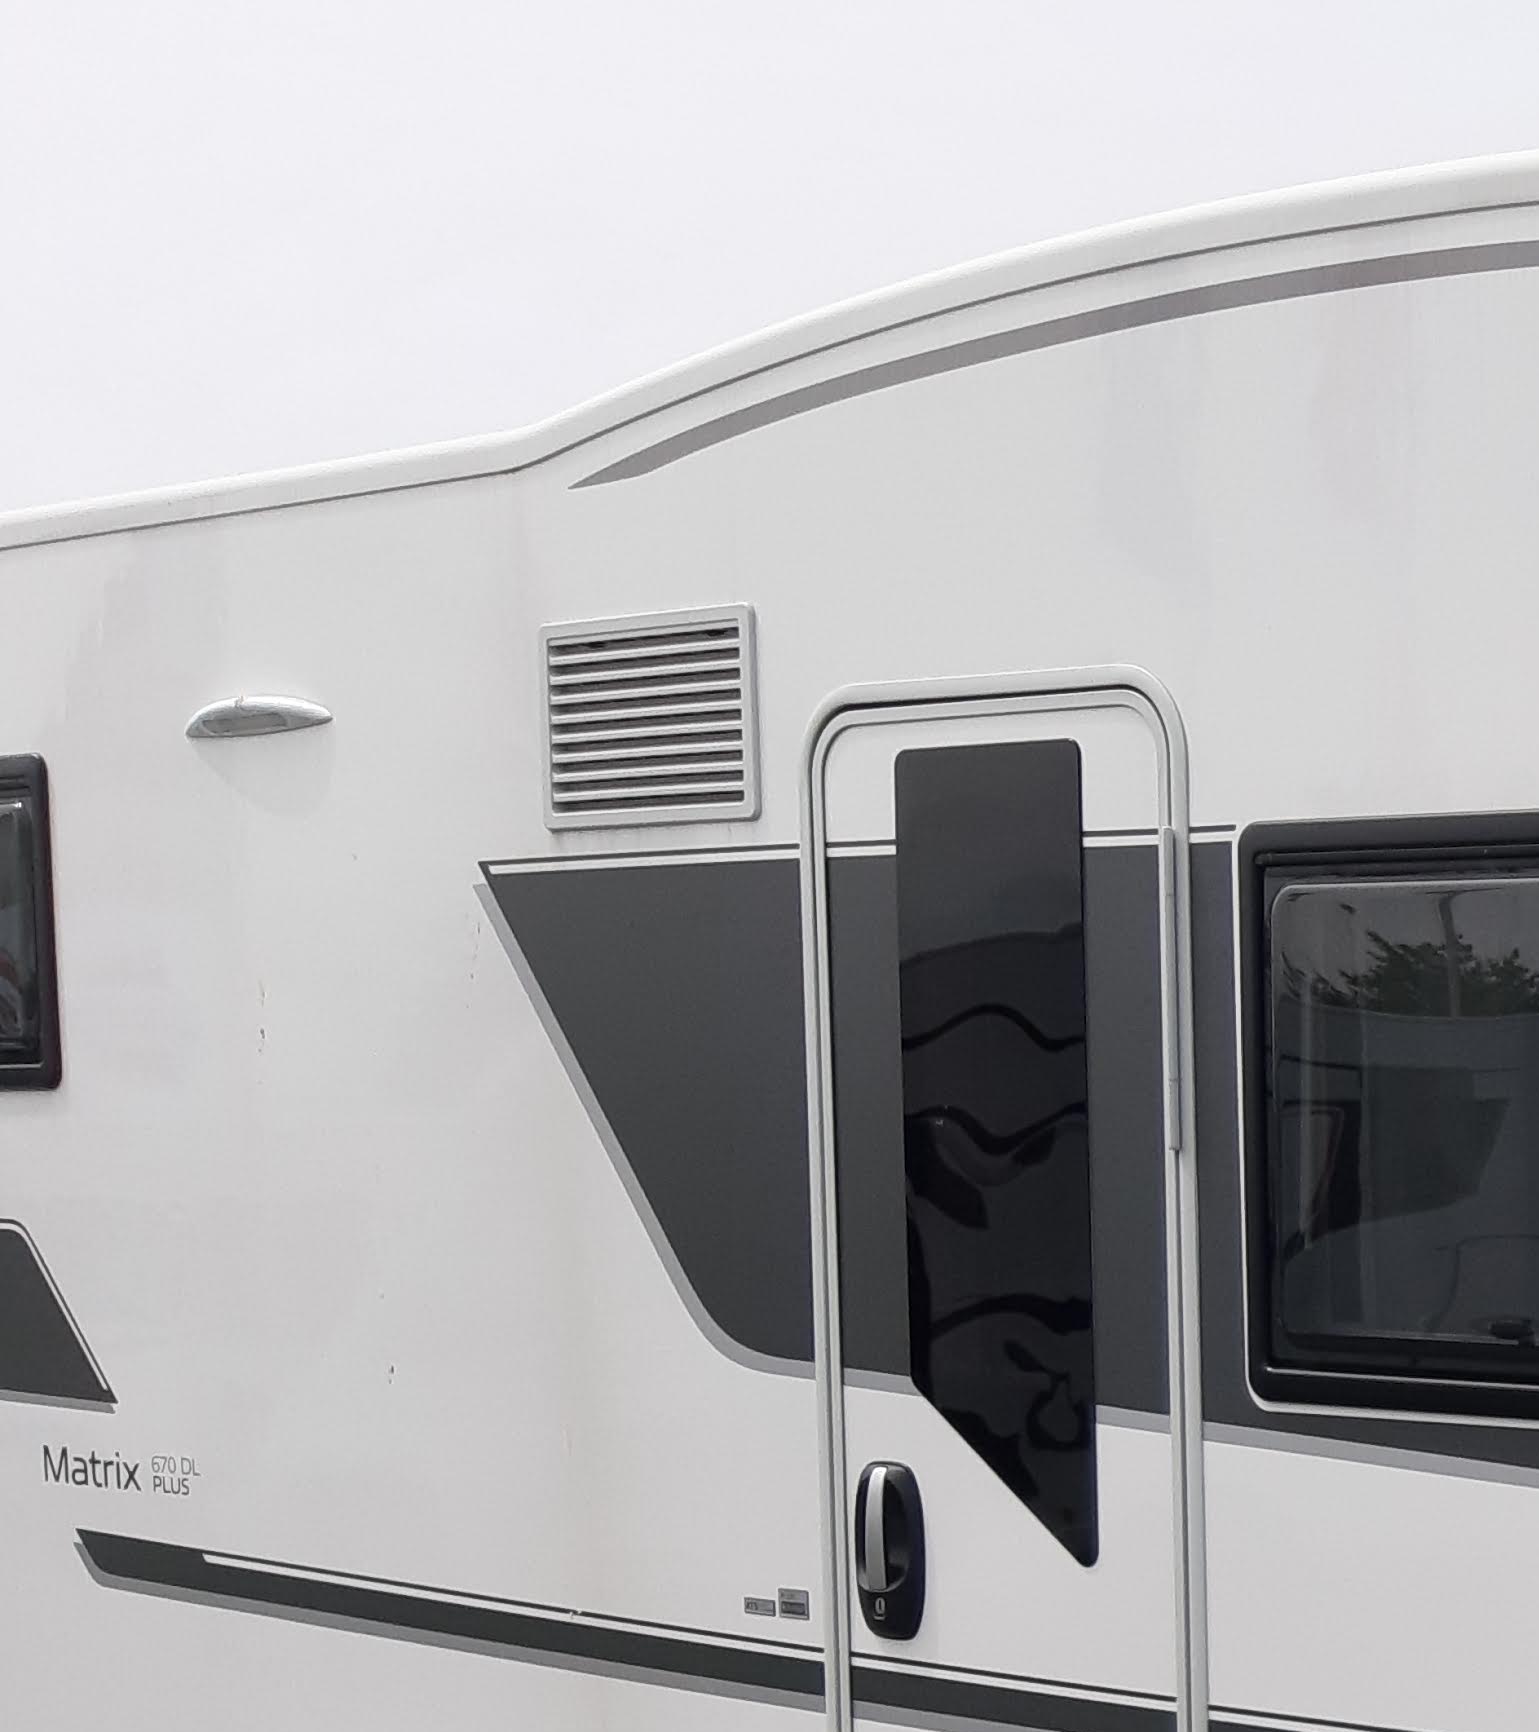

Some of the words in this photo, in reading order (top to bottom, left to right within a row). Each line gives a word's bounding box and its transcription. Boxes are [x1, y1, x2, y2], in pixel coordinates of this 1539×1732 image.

[42, 1444, 142, 1492] Matrix
[151, 1455, 177, 1474] 670
[180, 1457, 200, 1477] DL
[152, 1475, 190, 1496] PLUS
